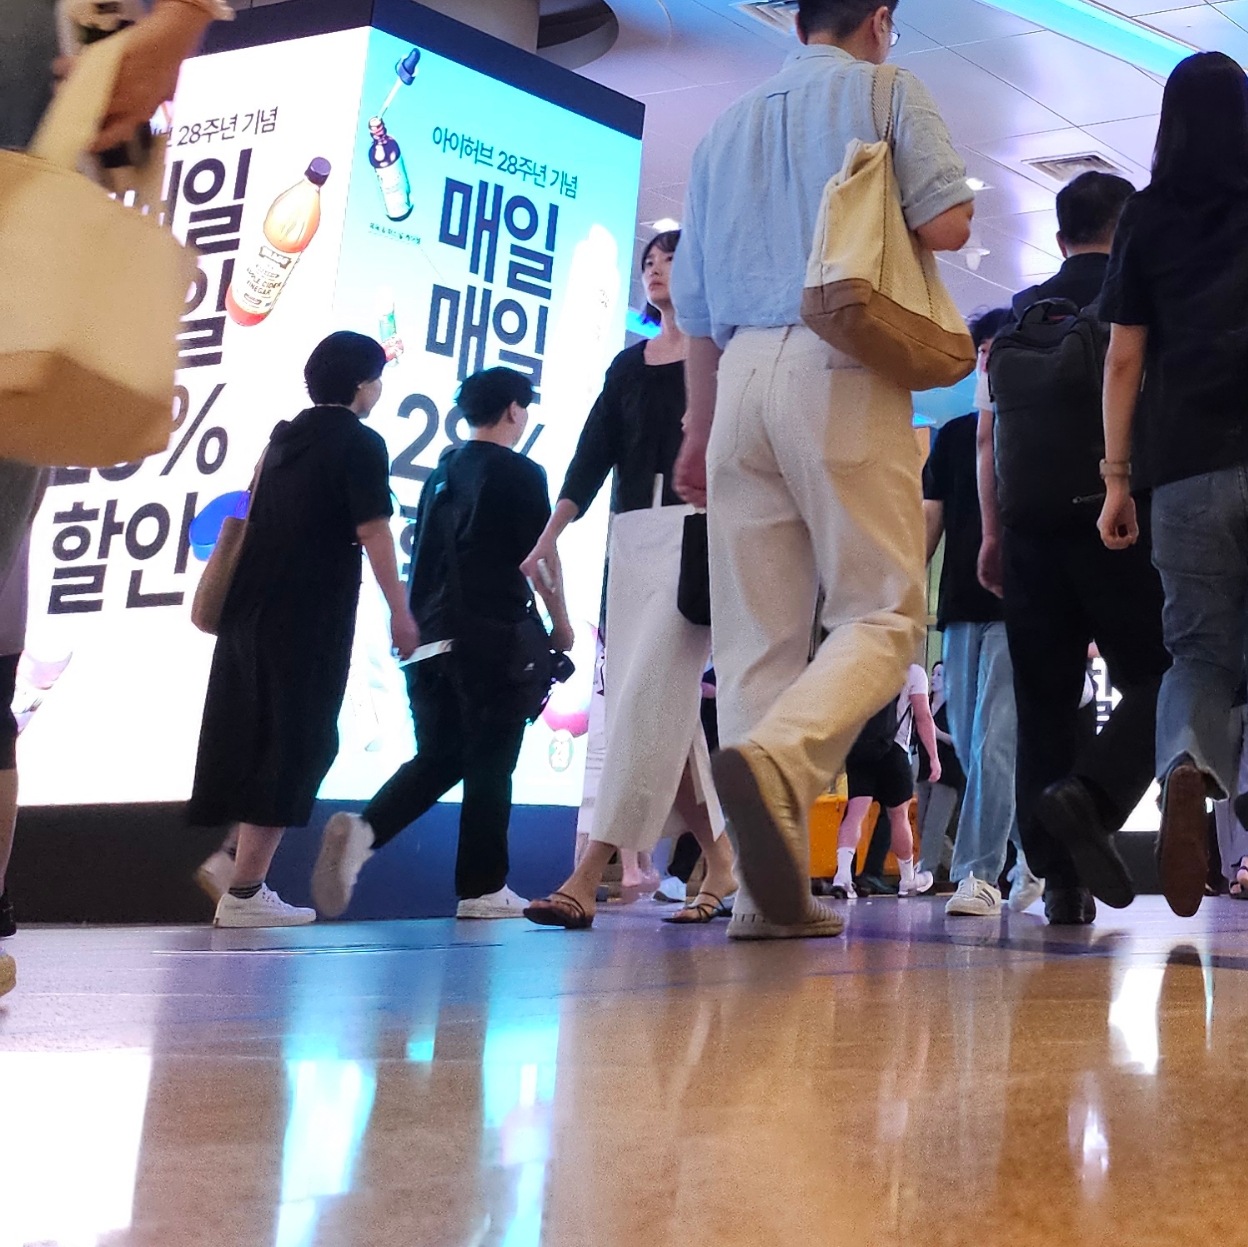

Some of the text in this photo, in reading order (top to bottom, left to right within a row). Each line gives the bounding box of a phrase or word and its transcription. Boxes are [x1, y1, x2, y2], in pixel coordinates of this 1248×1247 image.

[177, 113, 238, 147] 28주년
[241, 106, 279, 135] 기념
[432, 126, 578, 199] 아이허브 28주년 기념
[164, 148, 253, 256] 일
[438, 176, 559, 301] 매일
[425, 283, 549, 404] 매일
[47, 491, 199, 615] 할인
